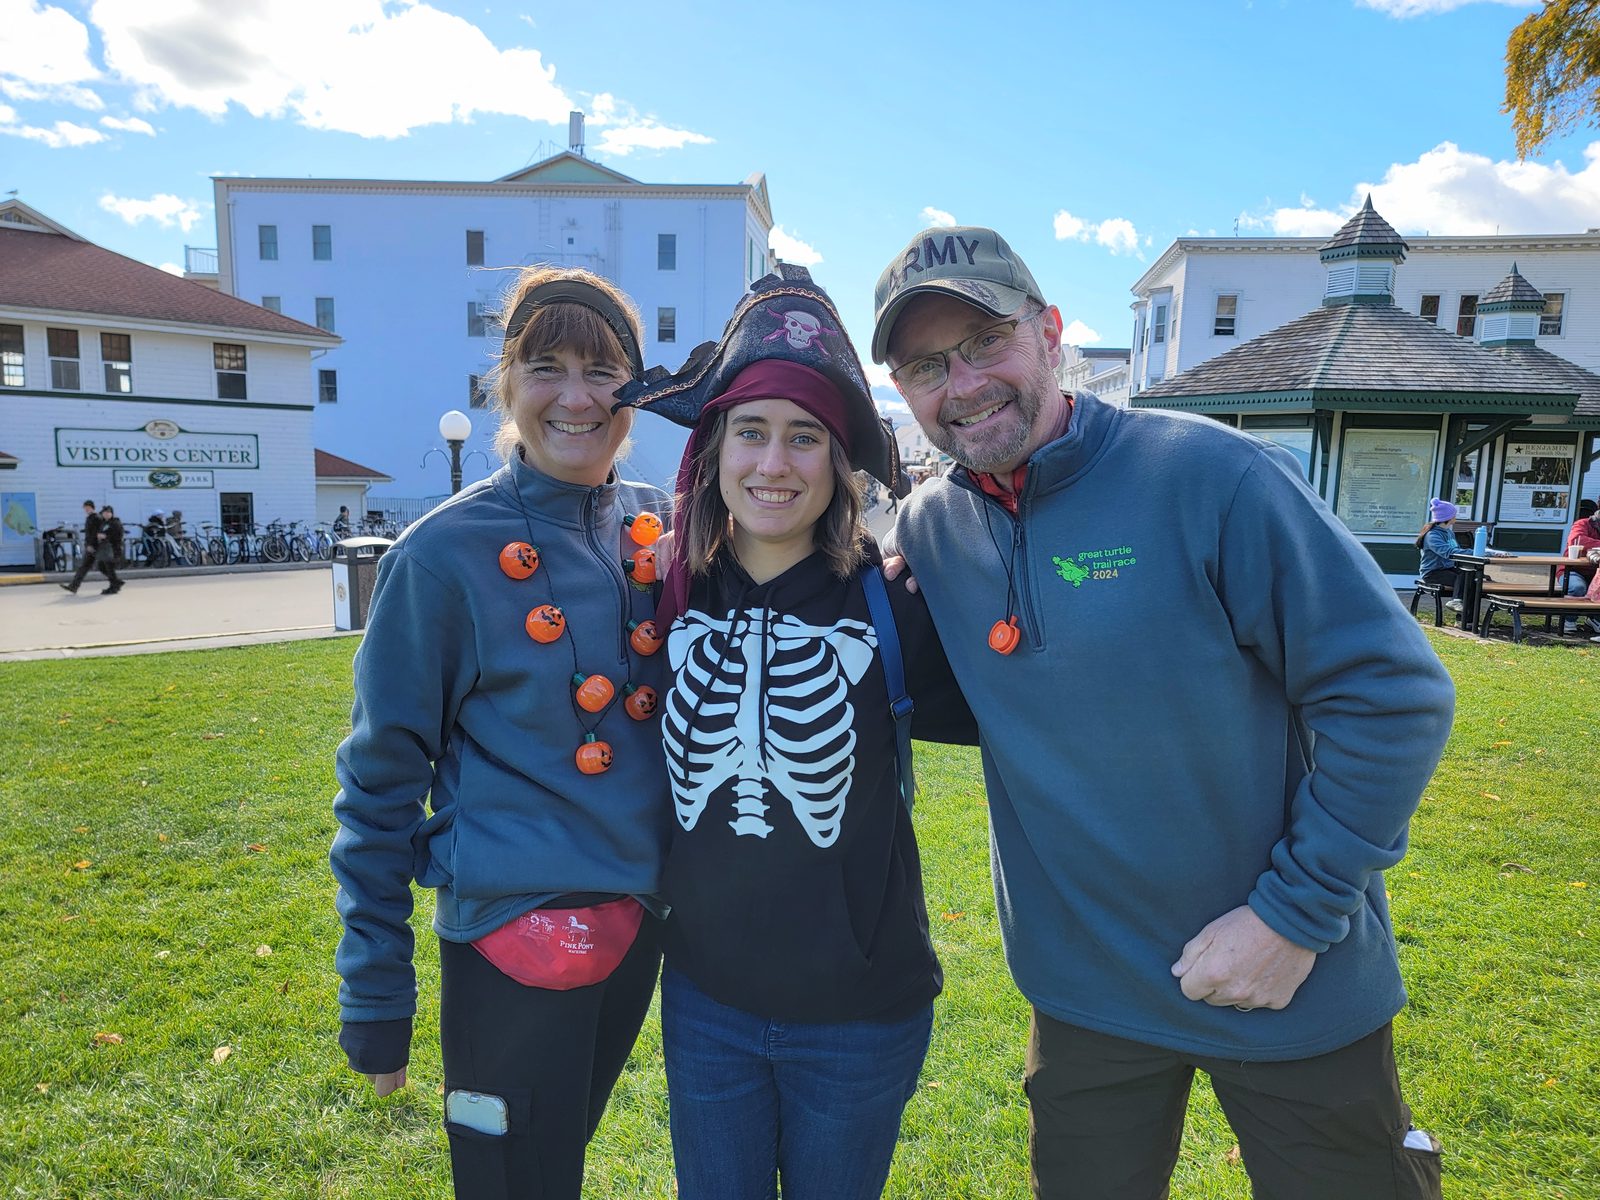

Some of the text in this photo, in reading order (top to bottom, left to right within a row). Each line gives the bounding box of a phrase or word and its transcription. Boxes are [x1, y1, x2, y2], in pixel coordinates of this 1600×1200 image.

[888, 235, 979, 291] ARMY
[65, 447, 253, 464] VISITOR'S CENTER
[1078, 546, 1132, 562] great turtle
[1093, 557, 1136, 569] trail race
[1092, 569, 1119, 579] 2024
